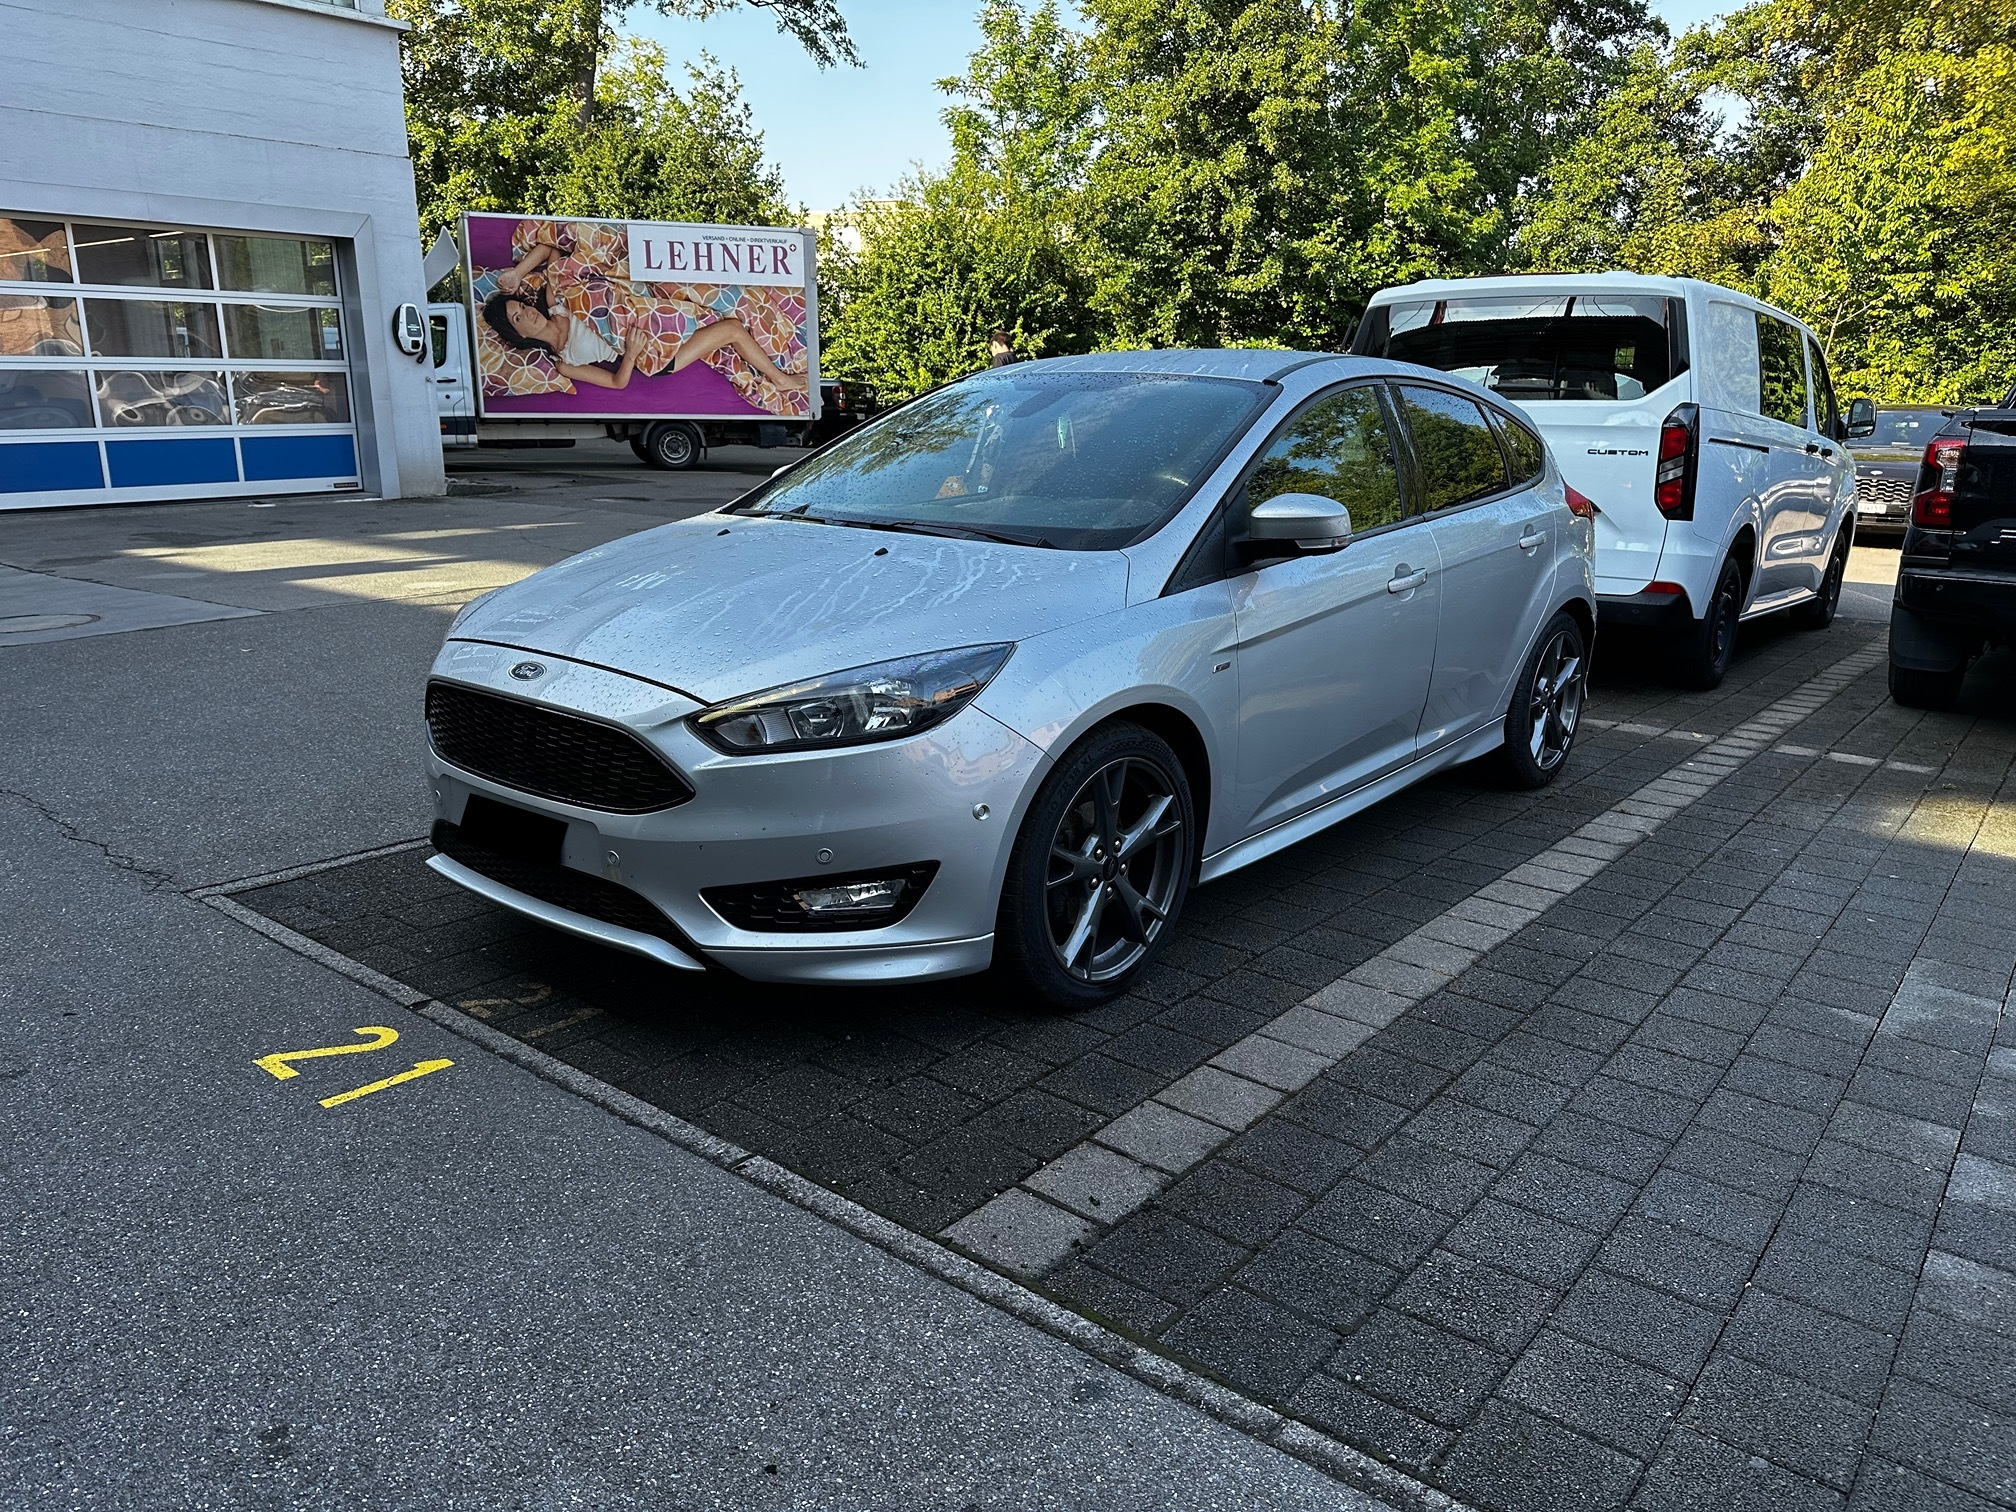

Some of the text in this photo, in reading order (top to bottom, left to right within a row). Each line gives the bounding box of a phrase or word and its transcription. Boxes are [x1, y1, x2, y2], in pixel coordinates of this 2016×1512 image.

[642, 239, 793, 275] LEHNER
[1069, 767, 1081, 781] 18
[1080, 754, 1095, 769] XL
[252, 1025, 455, 1109] 21
